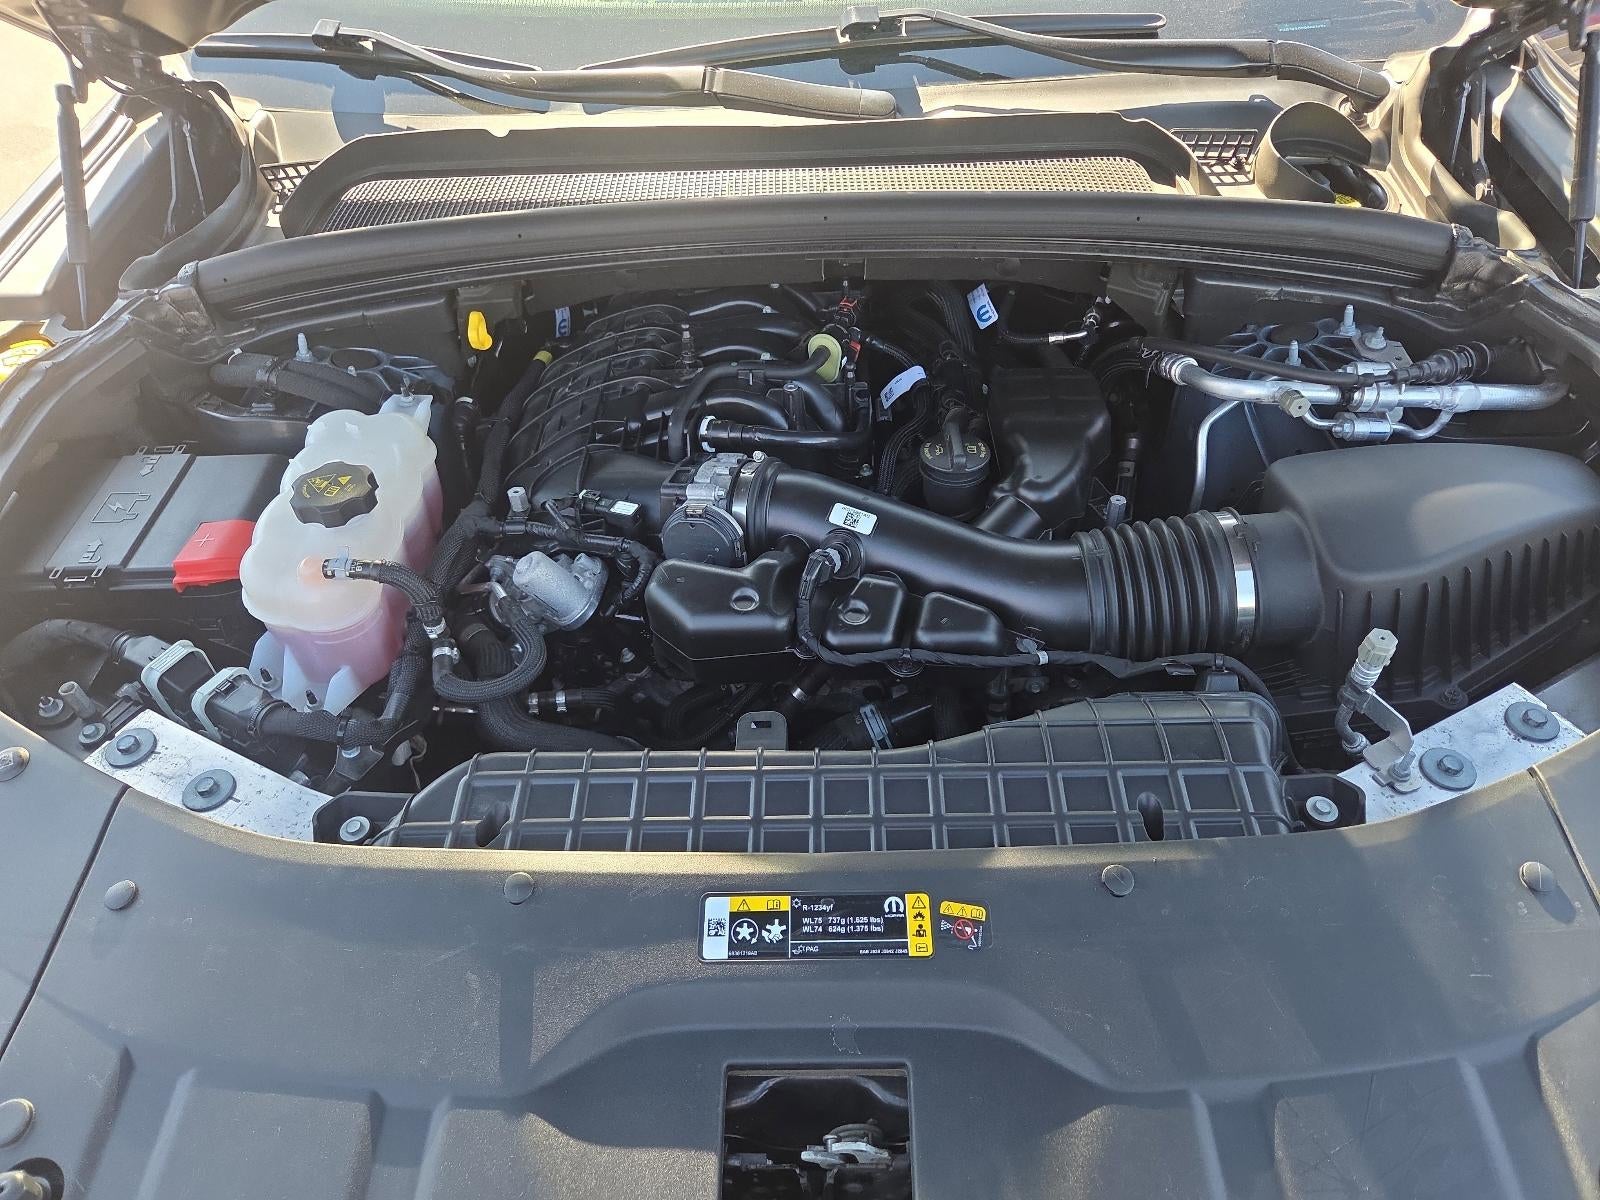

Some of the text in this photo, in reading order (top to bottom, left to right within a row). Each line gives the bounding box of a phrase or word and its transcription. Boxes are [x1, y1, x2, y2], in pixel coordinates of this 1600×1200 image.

[802, 904, 834, 912] R-1234yf
[828, 917, 846, 925] 737g
[847, 916, 869, 924] (1.625
[870, 916, 884, 924] lbs)
[828, 926, 846, 934] 624g
[847, 925, 869, 934] (1.375
[870, 925, 884, 934] lbs)
[805, 945, 819, 953] PAG
